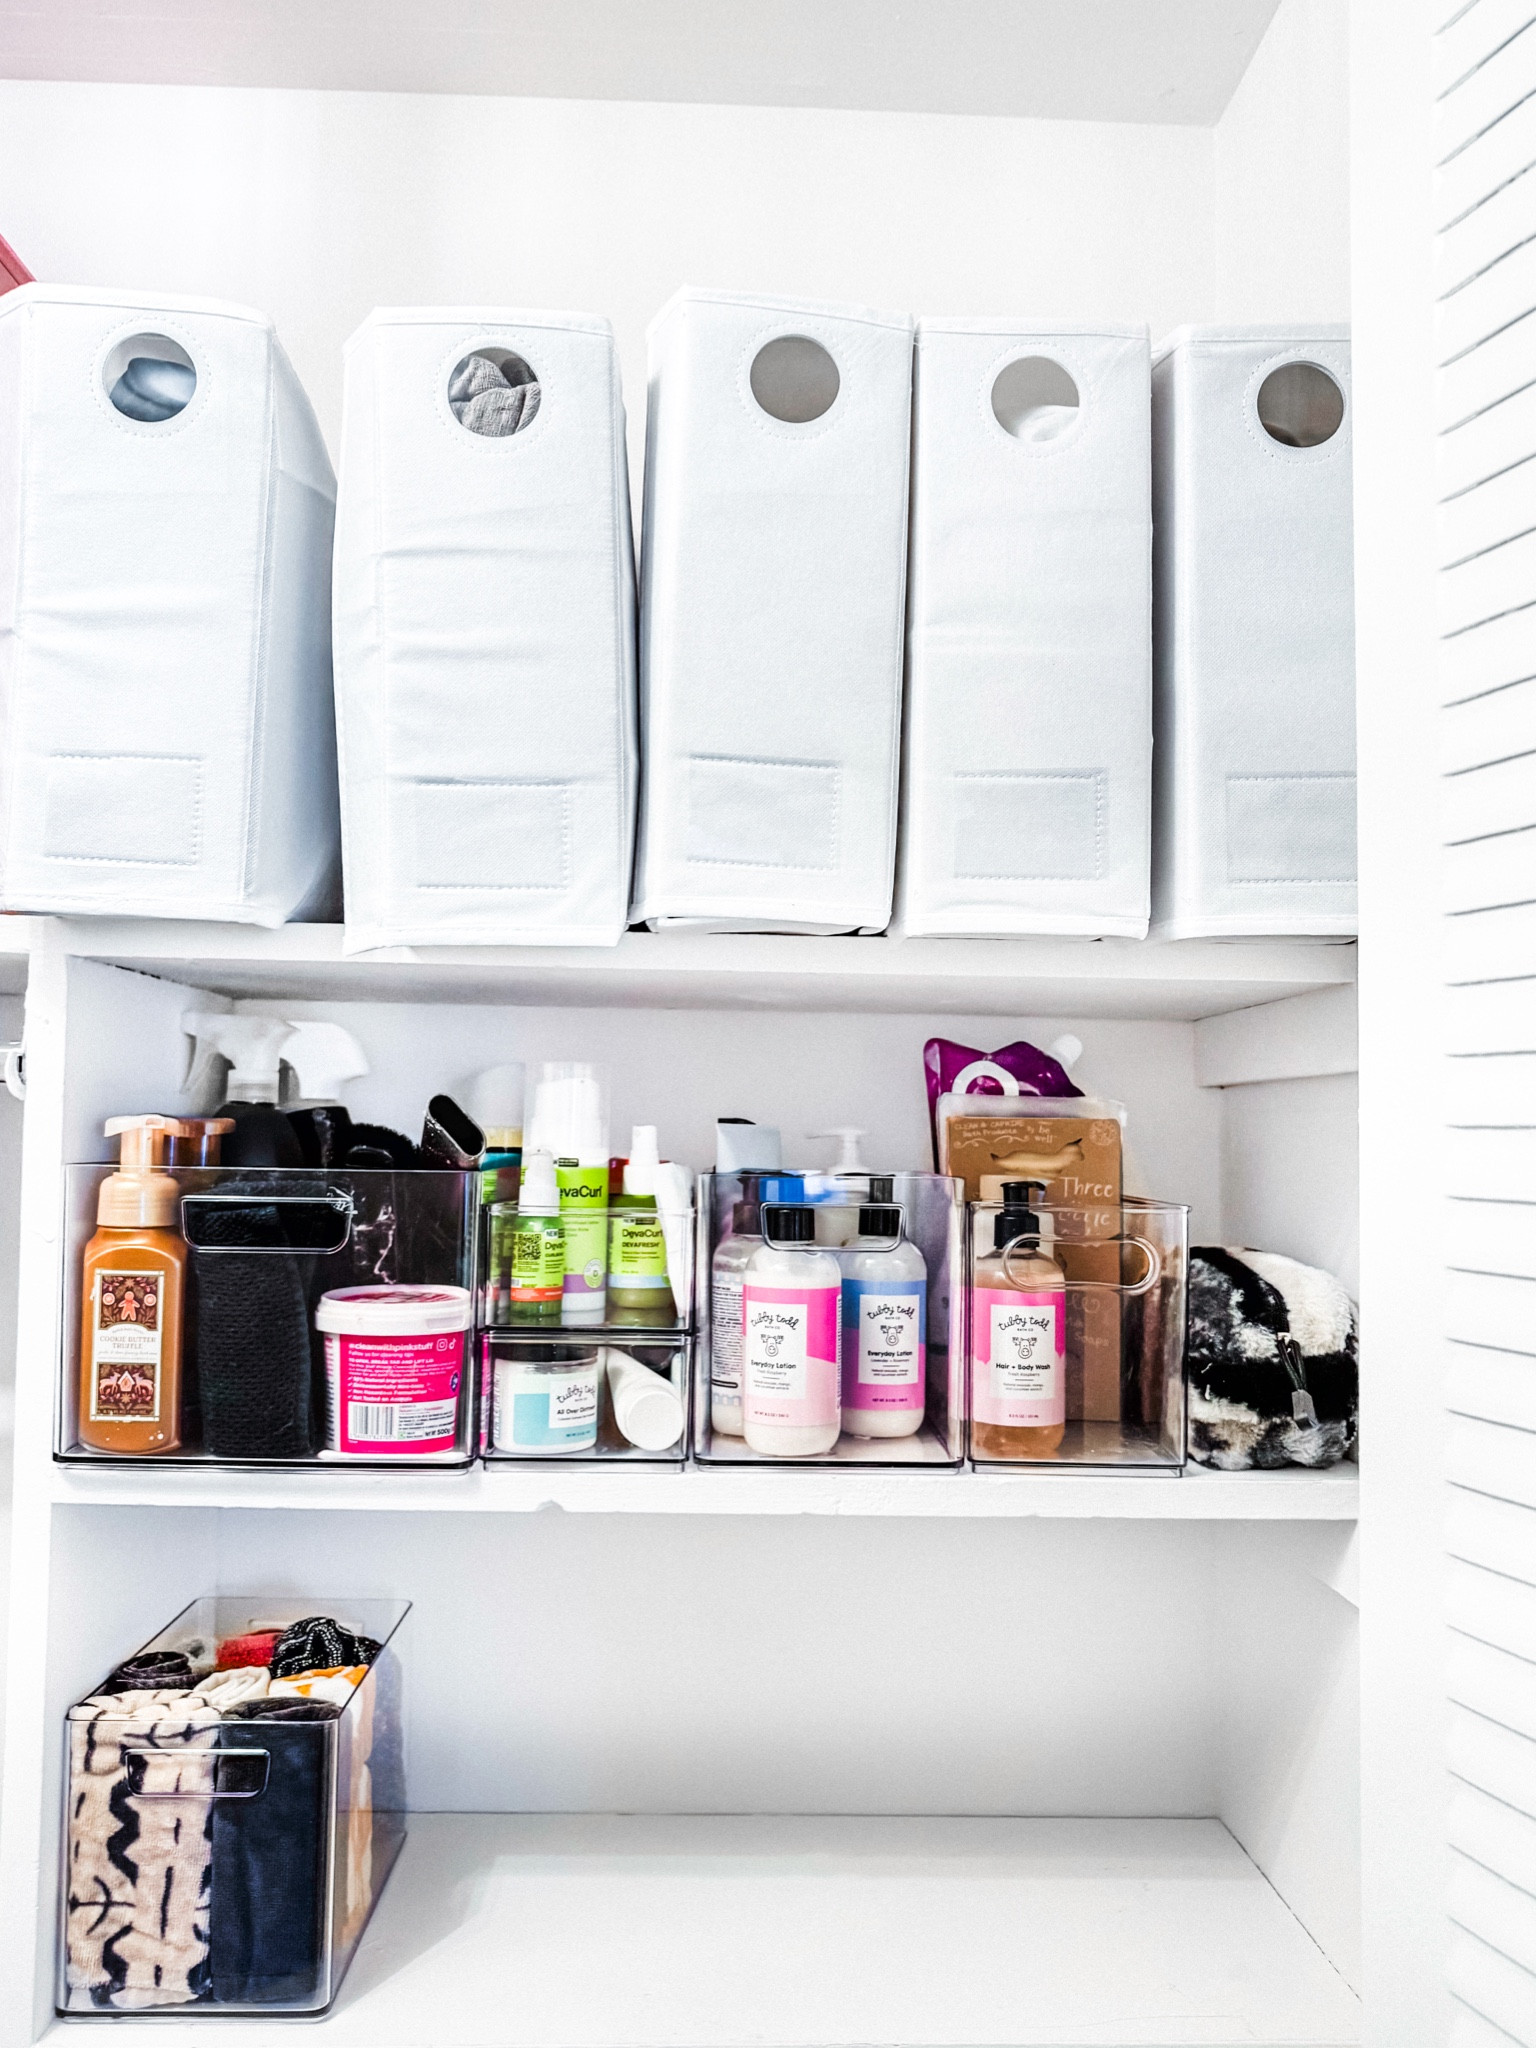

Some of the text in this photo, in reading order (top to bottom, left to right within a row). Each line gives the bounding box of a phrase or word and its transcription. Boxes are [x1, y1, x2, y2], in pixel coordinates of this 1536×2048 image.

[560, 1185, 603, 1198] evaCurl
[1059, 1176, 1114, 1198] Three
[866, 1303, 916, 1320] tubby todd
[750, 1311, 800, 1331] tubby todd
[997, 1314, 1027, 1331] tubby
[1028, 1316, 1051, 1332] todd
[867, 1350, 895, 1358] Everyday
[750, 1359, 797, 1370] Everyday Lotion
[995, 1362, 1009, 1370] Hair
[1017, 1363, 1034, 1371] Body
